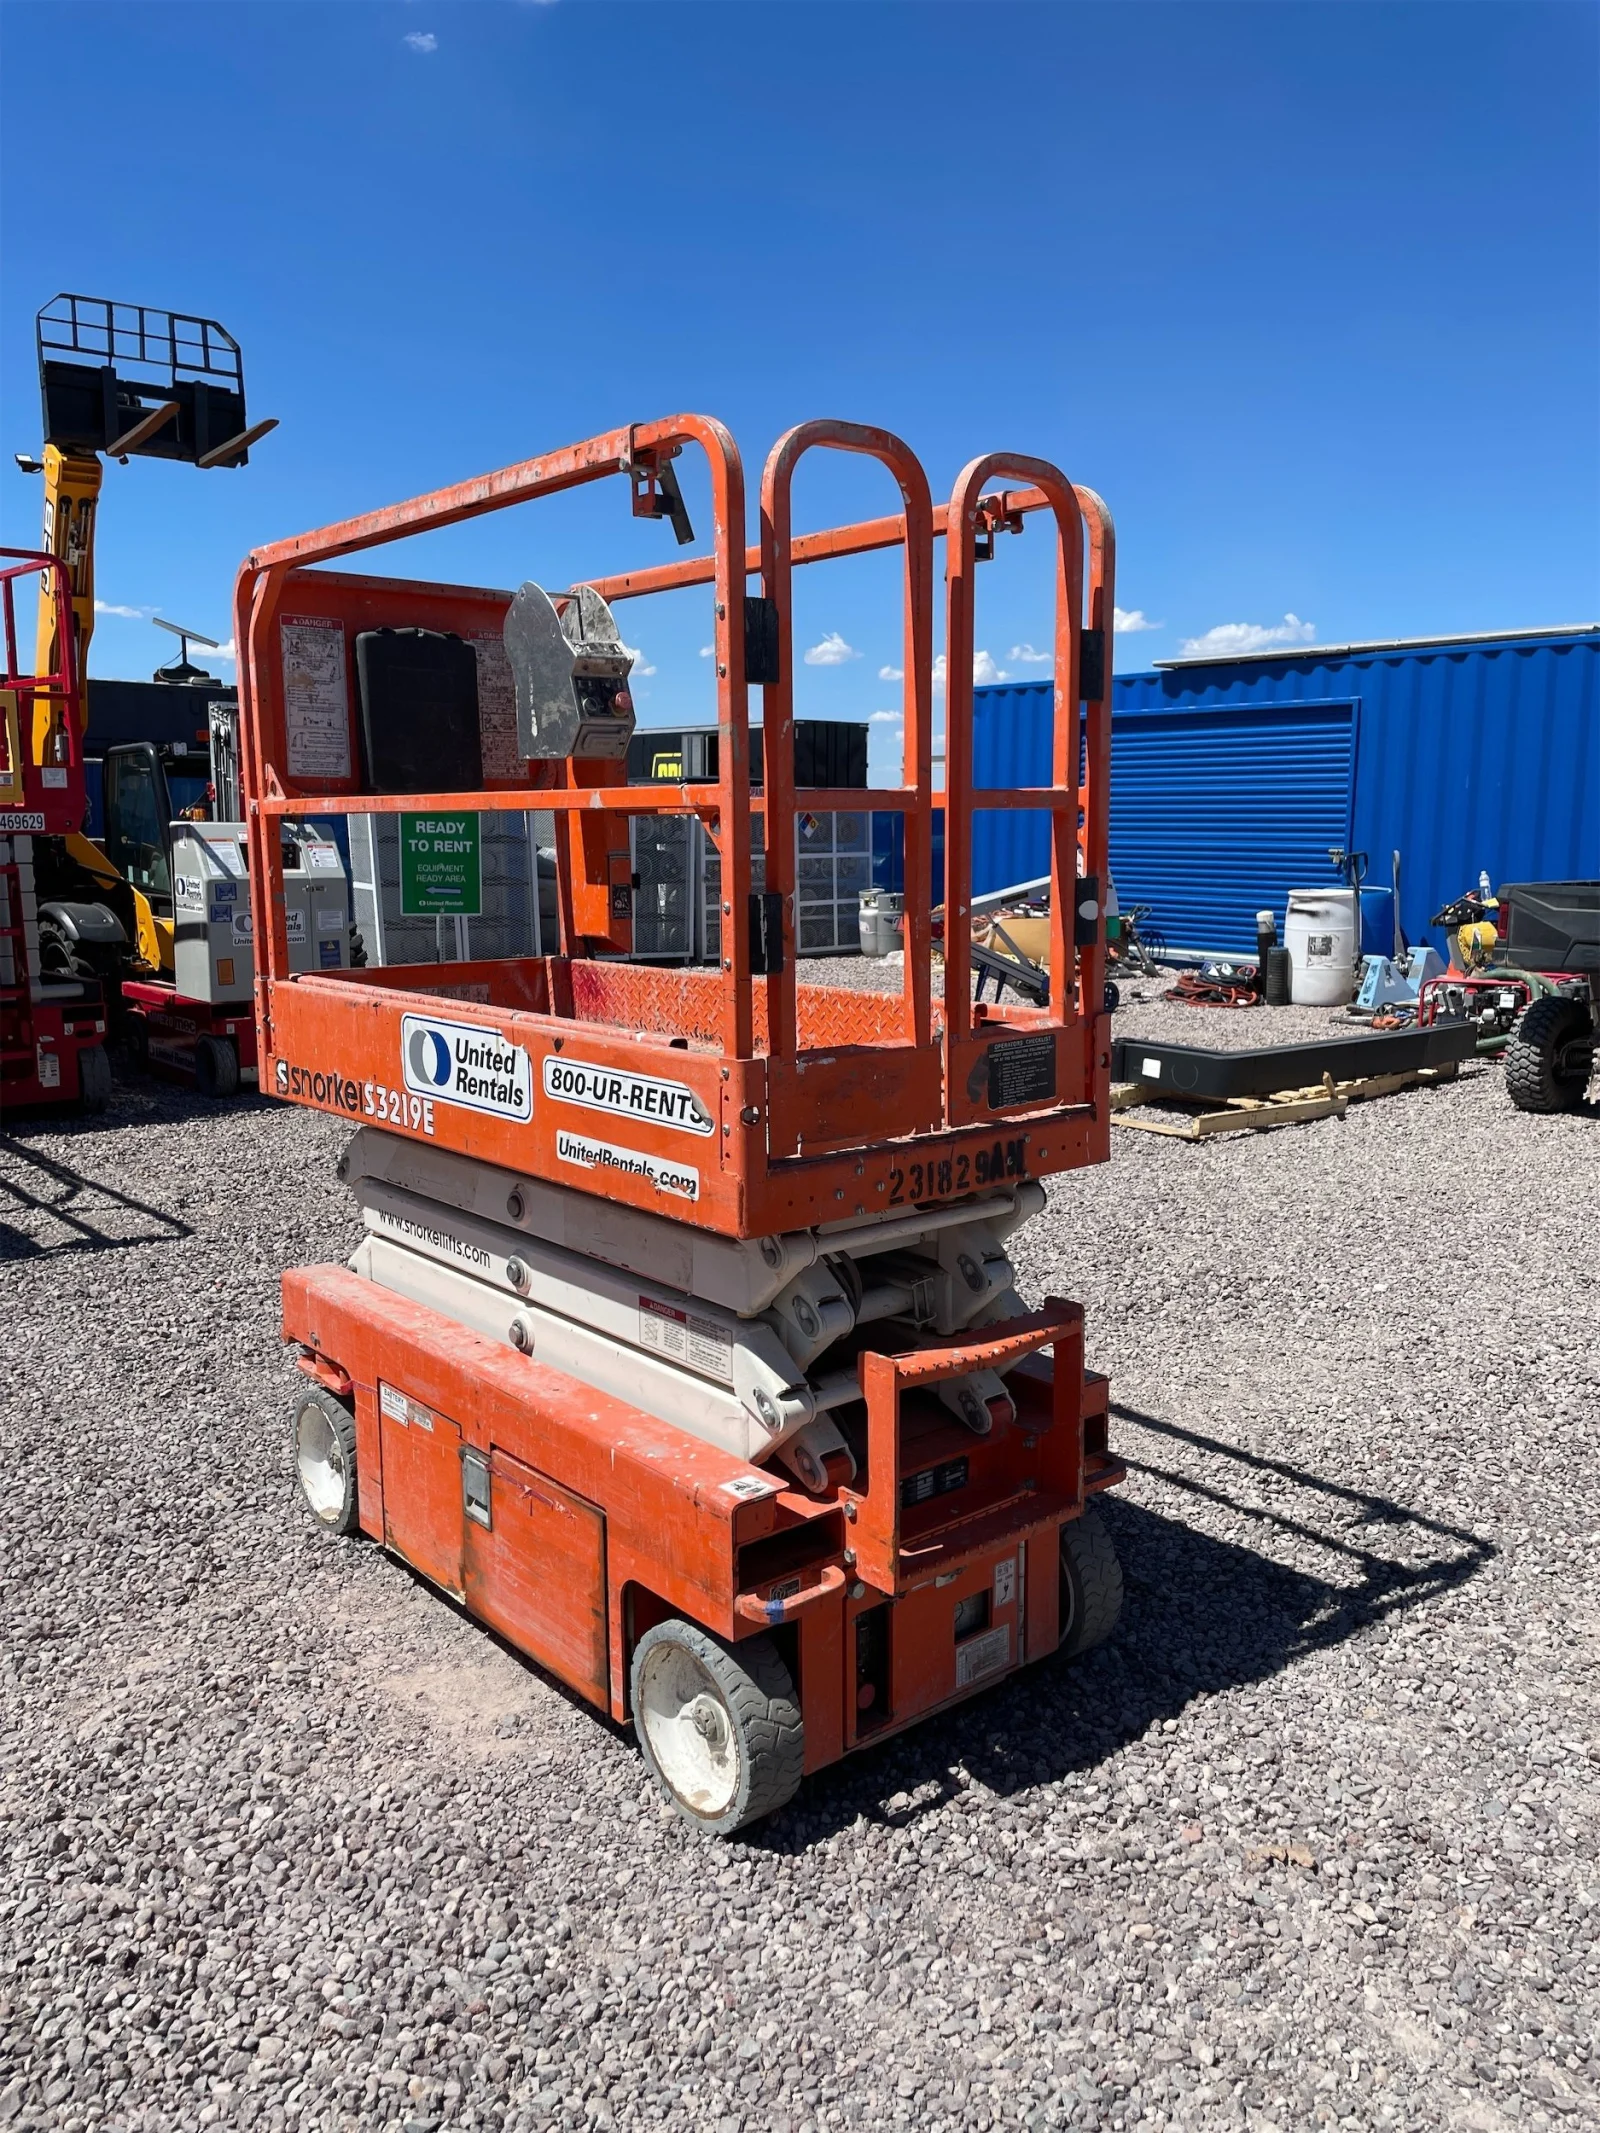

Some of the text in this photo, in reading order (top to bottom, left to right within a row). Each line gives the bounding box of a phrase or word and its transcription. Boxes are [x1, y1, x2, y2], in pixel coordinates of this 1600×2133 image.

[299, 619, 333, 628] DANGER
[0, 815, 43, 829] 469629
[416, 821, 465, 834] READY
[408, 839, 473, 853] TO RENT
[418, 863, 464, 873] EQUIPMENT
[416, 874, 466, 882] READY AREA
[456, 1037, 516, 1075] United
[291, 1066, 364, 1113] snorkel
[456, 1067, 523, 1107] Rentals
[364, 1082, 434, 1135] S3219E
[559, 1137, 697, 1195] UnitedRentals.com
[379, 1208, 490, 1268] www.snorkellifts.com
[653, 1303, 676, 1317] DANGER
